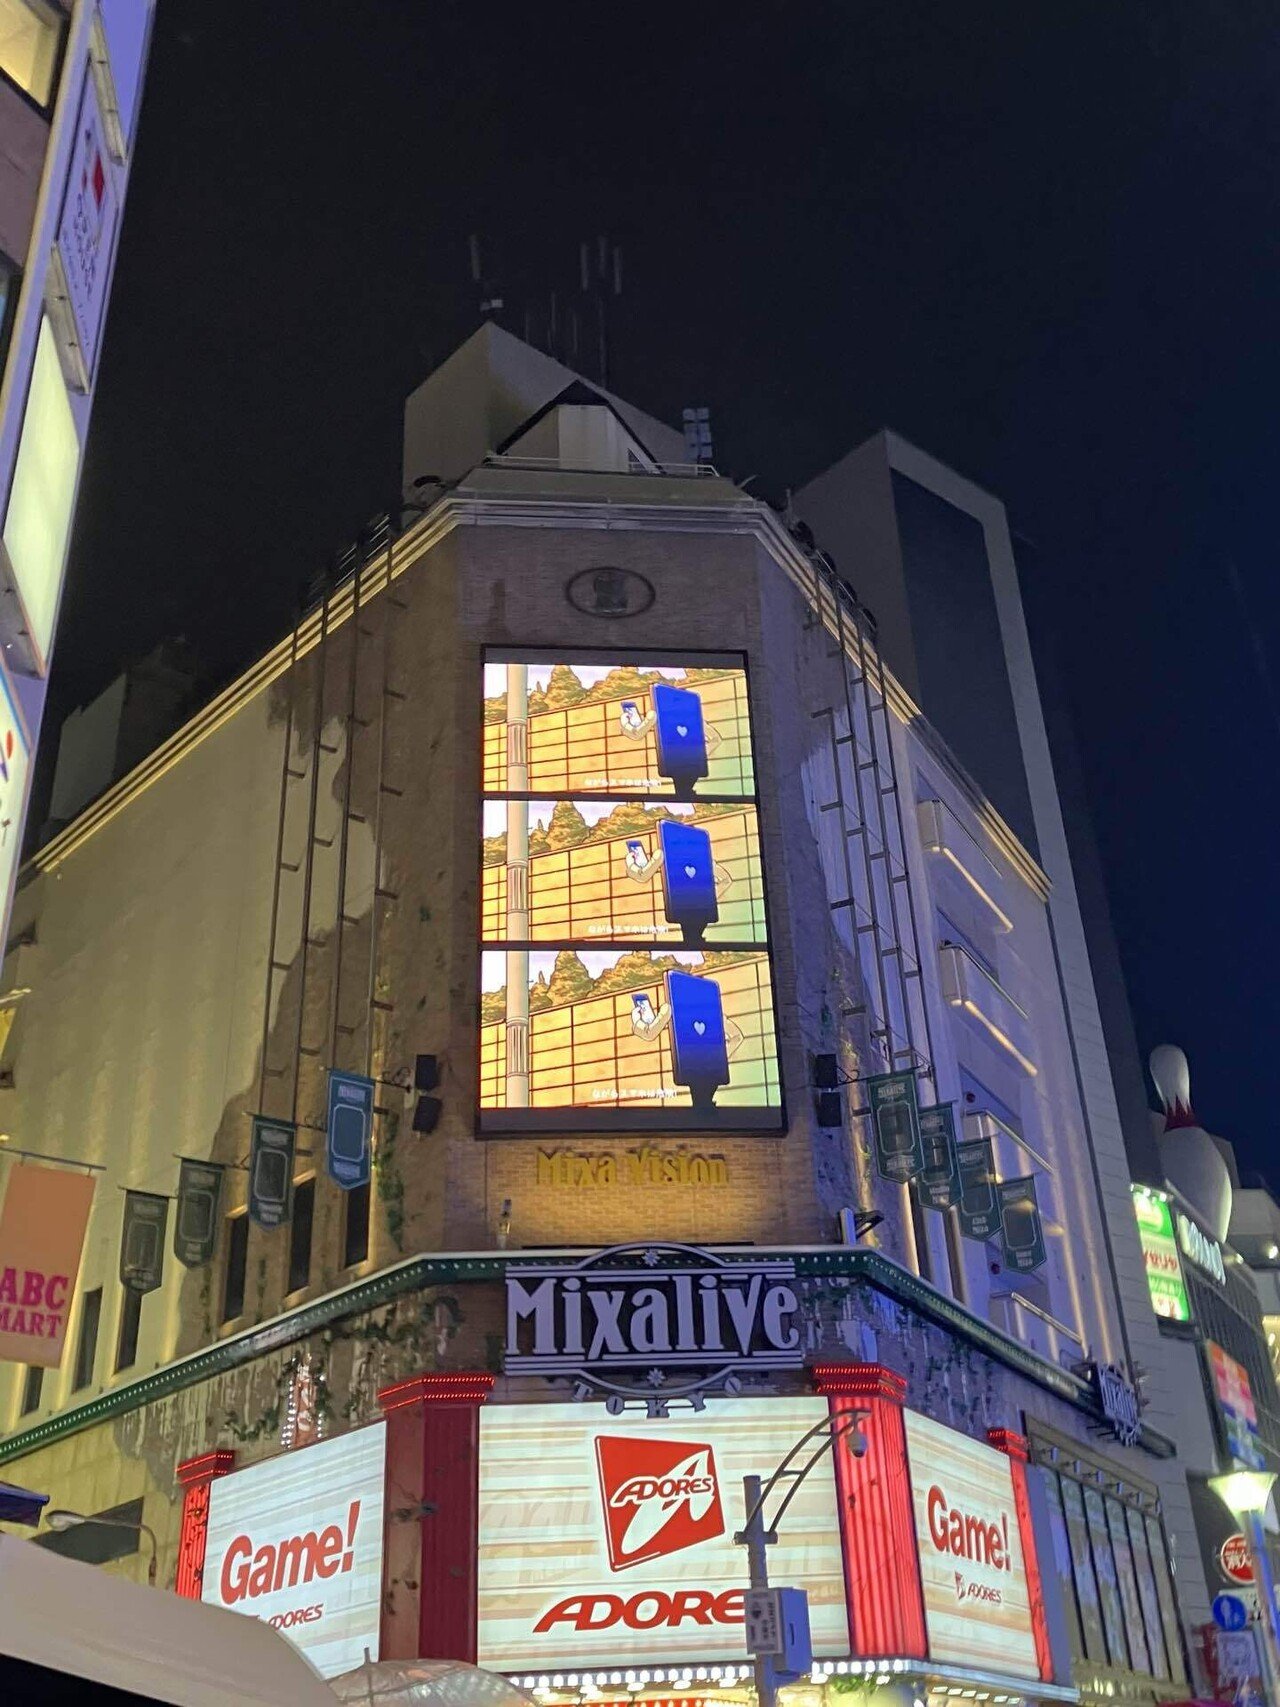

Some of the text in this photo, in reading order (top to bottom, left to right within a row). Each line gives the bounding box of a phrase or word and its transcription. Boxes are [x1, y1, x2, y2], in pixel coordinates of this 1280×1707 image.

[536, 1142, 728, 1186] Mixa Vision
[0, 1268, 69, 1310] ABC
[505, 1274, 800, 1361] Mixalive
[571, 1377, 742, 1418] TOKYO
[614, 1475, 713, 1507] ADORES
[927, 1485, 1011, 1571] Game!
[220, 1499, 361, 1604] Game!
[534, 1589, 745, 1633] ADORE
